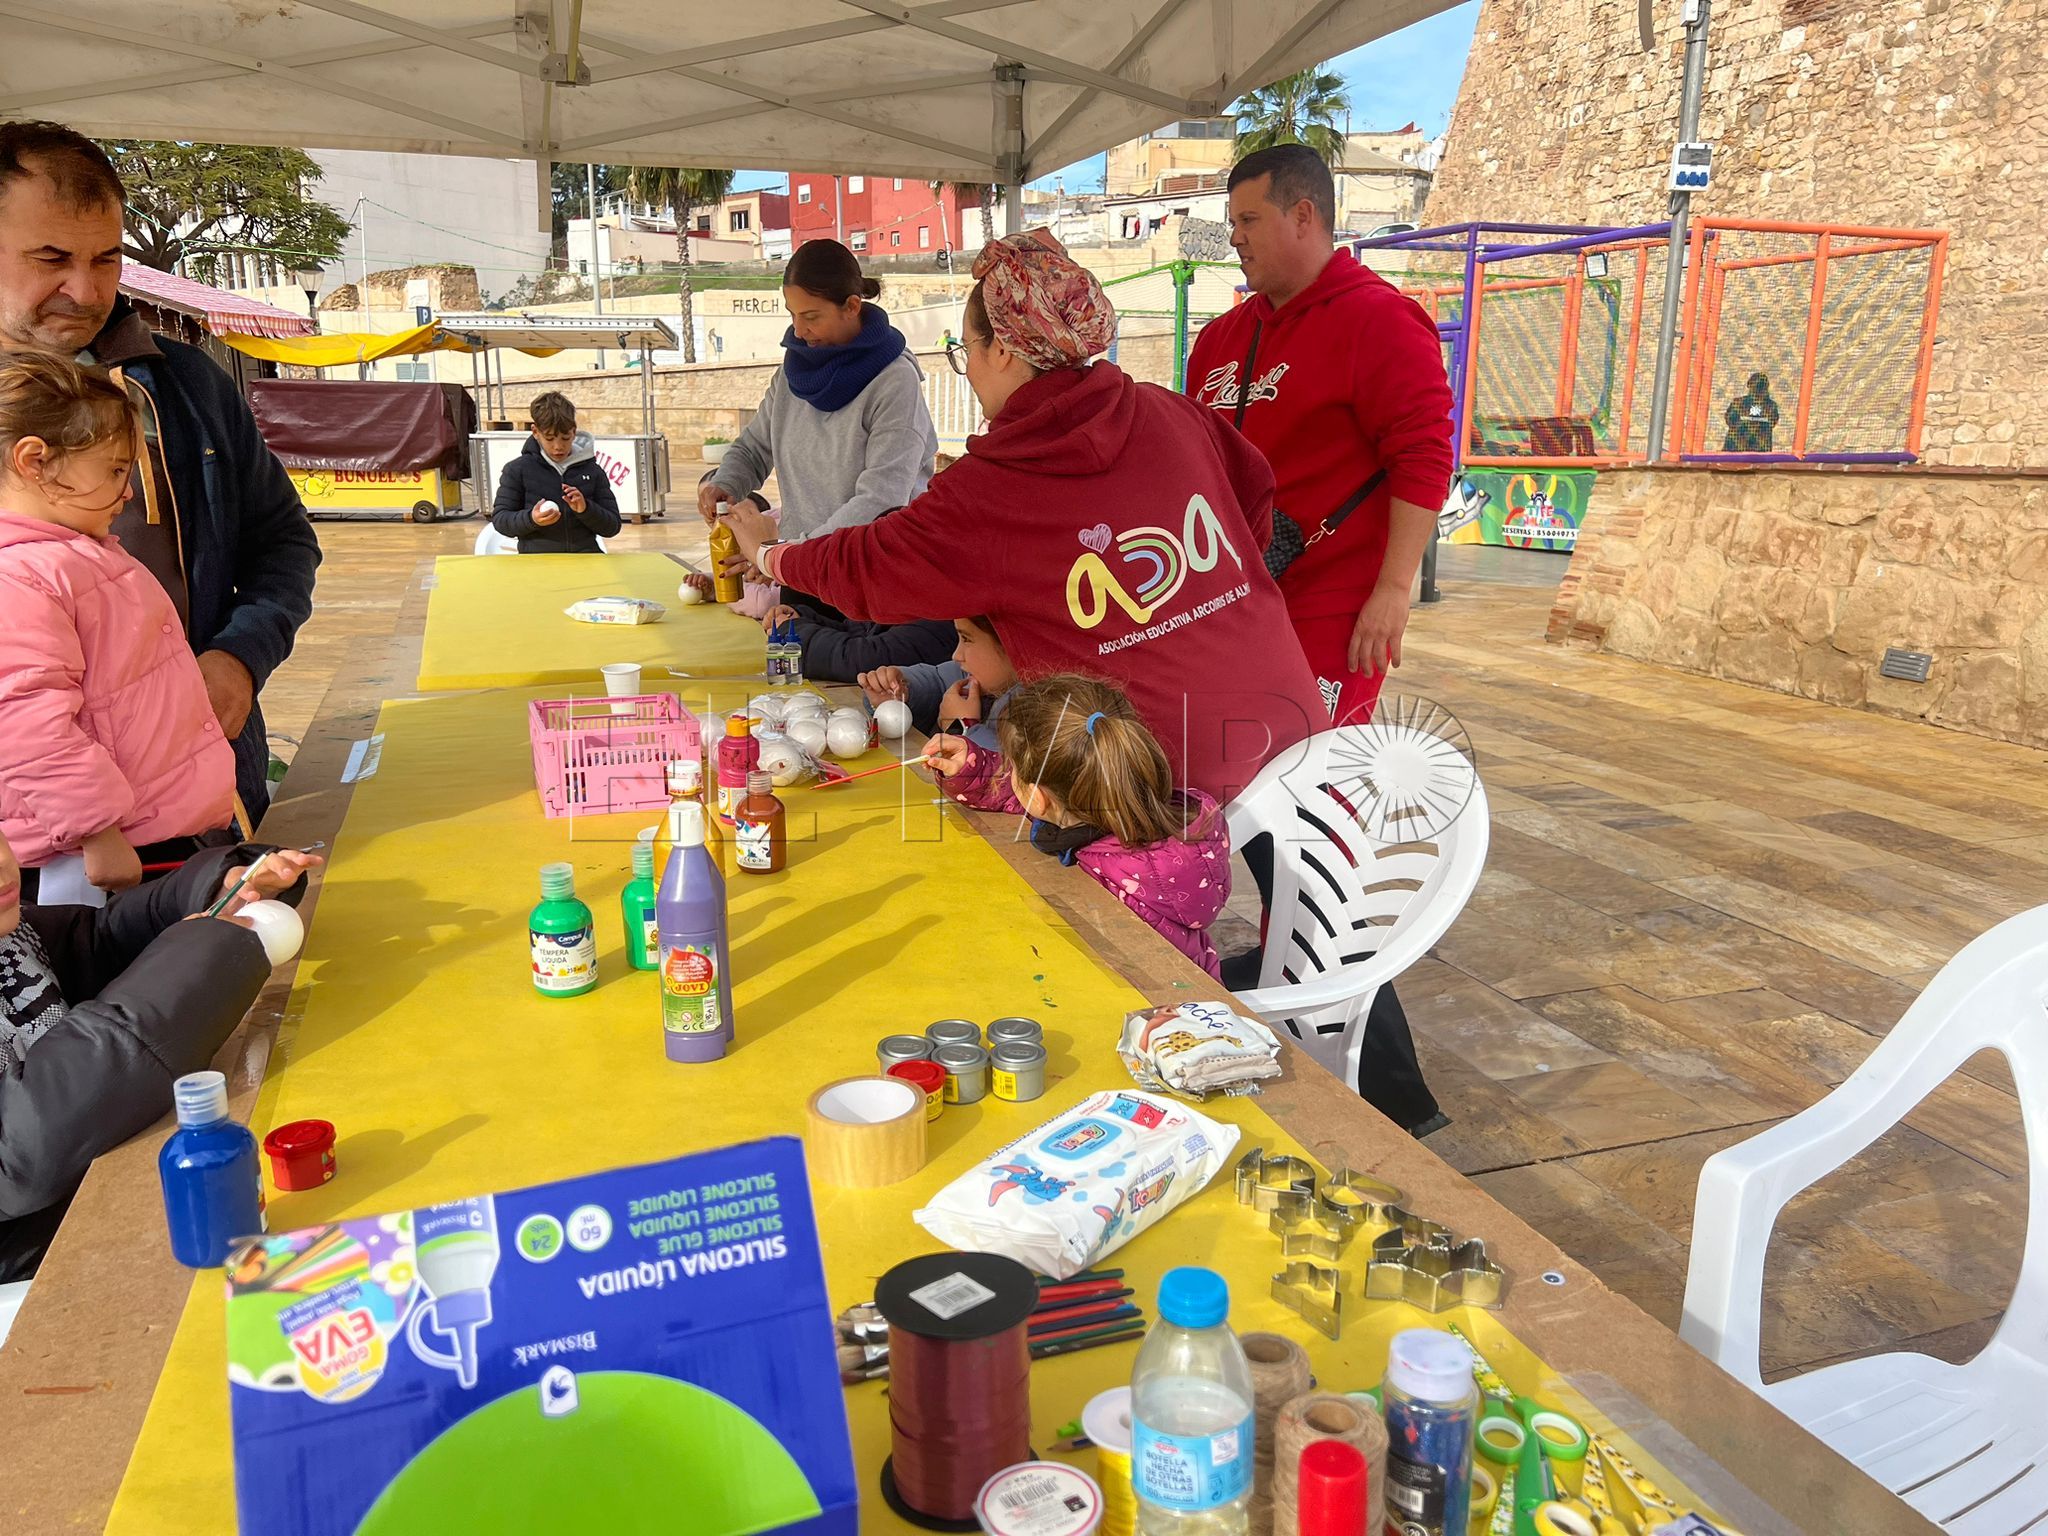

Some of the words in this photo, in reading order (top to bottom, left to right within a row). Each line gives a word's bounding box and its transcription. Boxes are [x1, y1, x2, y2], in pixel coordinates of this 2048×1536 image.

[422, 309, 429, 323] P
[1098, 631, 1146, 656] ASOCIACIÓN
[1146, 611, 1193, 640] EDUCATIVA
[1192, 595, 1226, 620] ARCOIRIS
[1226, 590, 1237, 604] DE
[675, 983, 706, 992] JOVI
[627, 1186, 697, 1216] LIQUIDE
[701, 1172, 776, 1202] SILICONE
[628, 1208, 700, 1239] LIQUIDA
[705, 1193, 780, 1224] SILICONE
[531, 1234, 552, 1251] 24
[580, 1225, 602, 1241] 60
[658, 1229, 703, 1255] GLUE
[708, 1214, 784, 1245] SILICONE
[680, 1234, 788, 1278] SILICONA
[576, 1259, 676, 1300] LÍQUIDA
[293, 1309, 375, 1366] EVA
[319, 1347, 370, 1377] GOMA
[1146, 1449, 1188, 1467] BOTELLA
[1151, 1461, 1185, 1475] HECHA
[1145, 1466, 1156, 1478] DE
[1158, 1471, 1192, 1483] OTRAS
[1145, 1474, 1193, 1492] BOTELLAS
